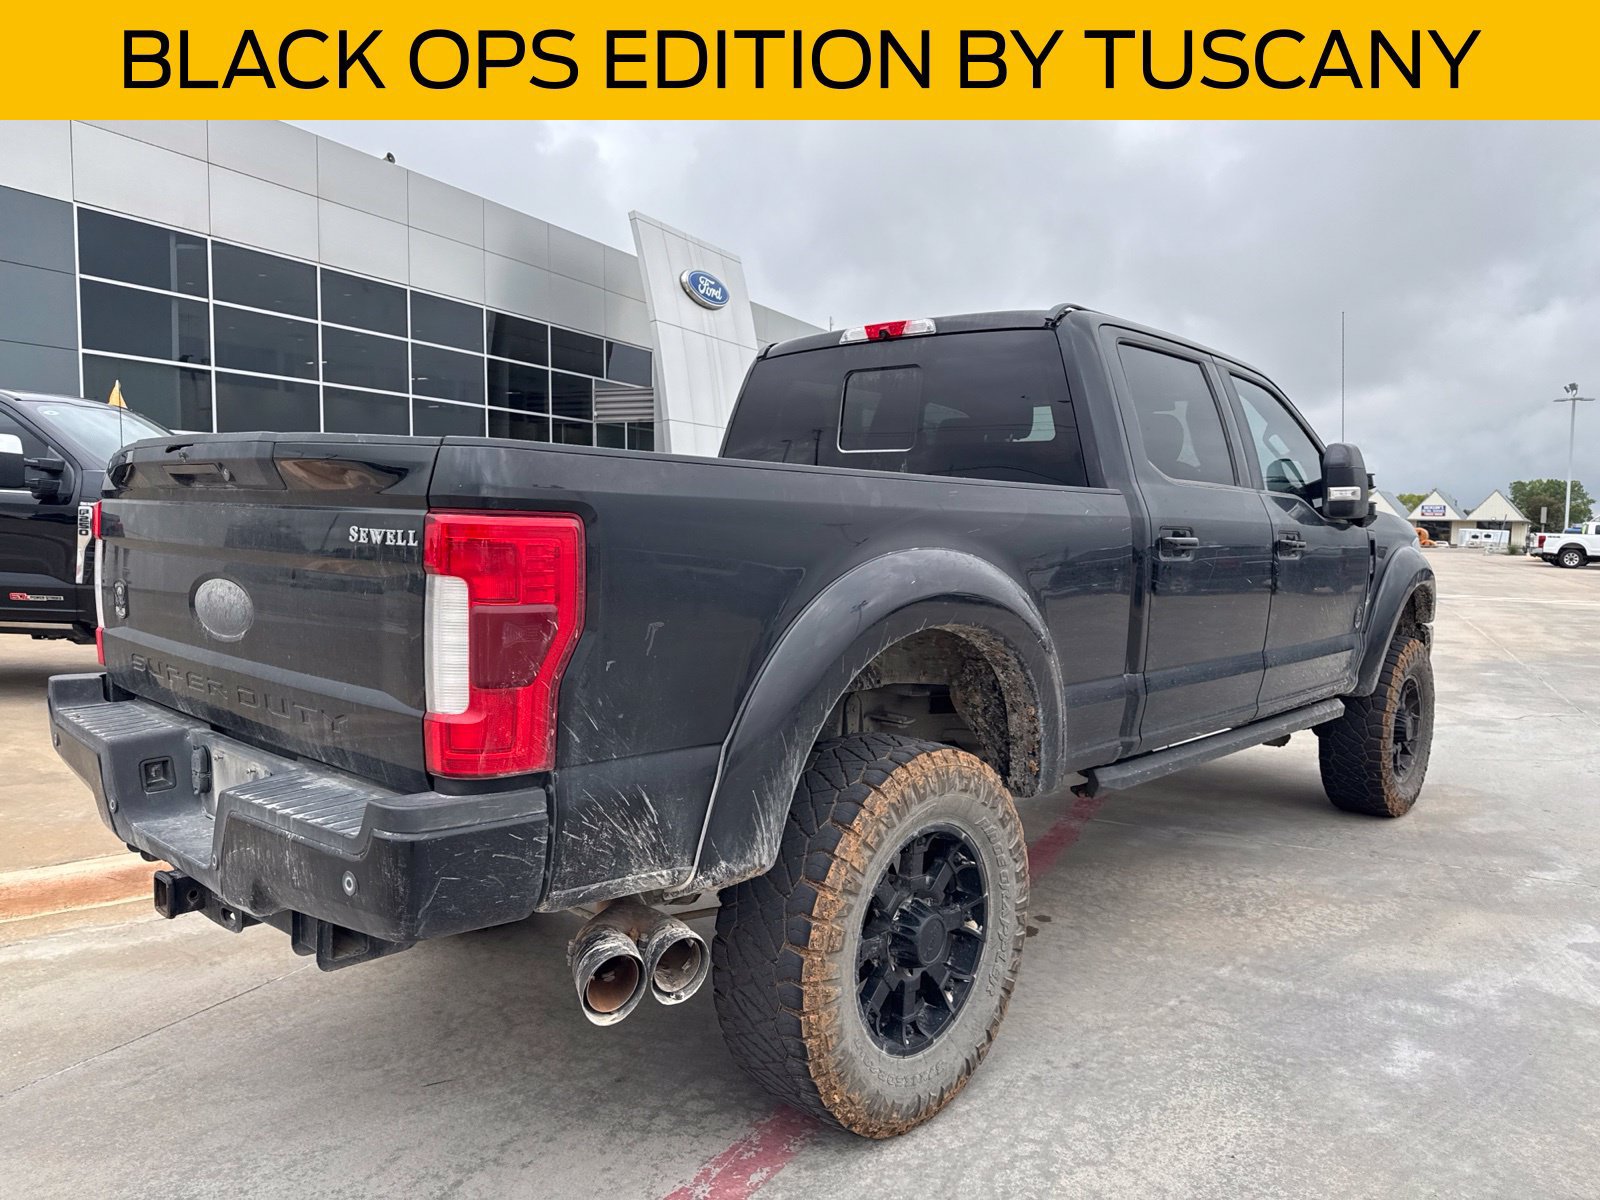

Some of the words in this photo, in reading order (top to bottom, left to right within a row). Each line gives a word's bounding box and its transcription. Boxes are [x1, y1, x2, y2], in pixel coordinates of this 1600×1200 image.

[698, 276, 722, 300] Ford
[348, 525, 418, 547] SEWELL
[131, 653, 228, 700] SUPER
[237, 685, 349, 734] DUTY
